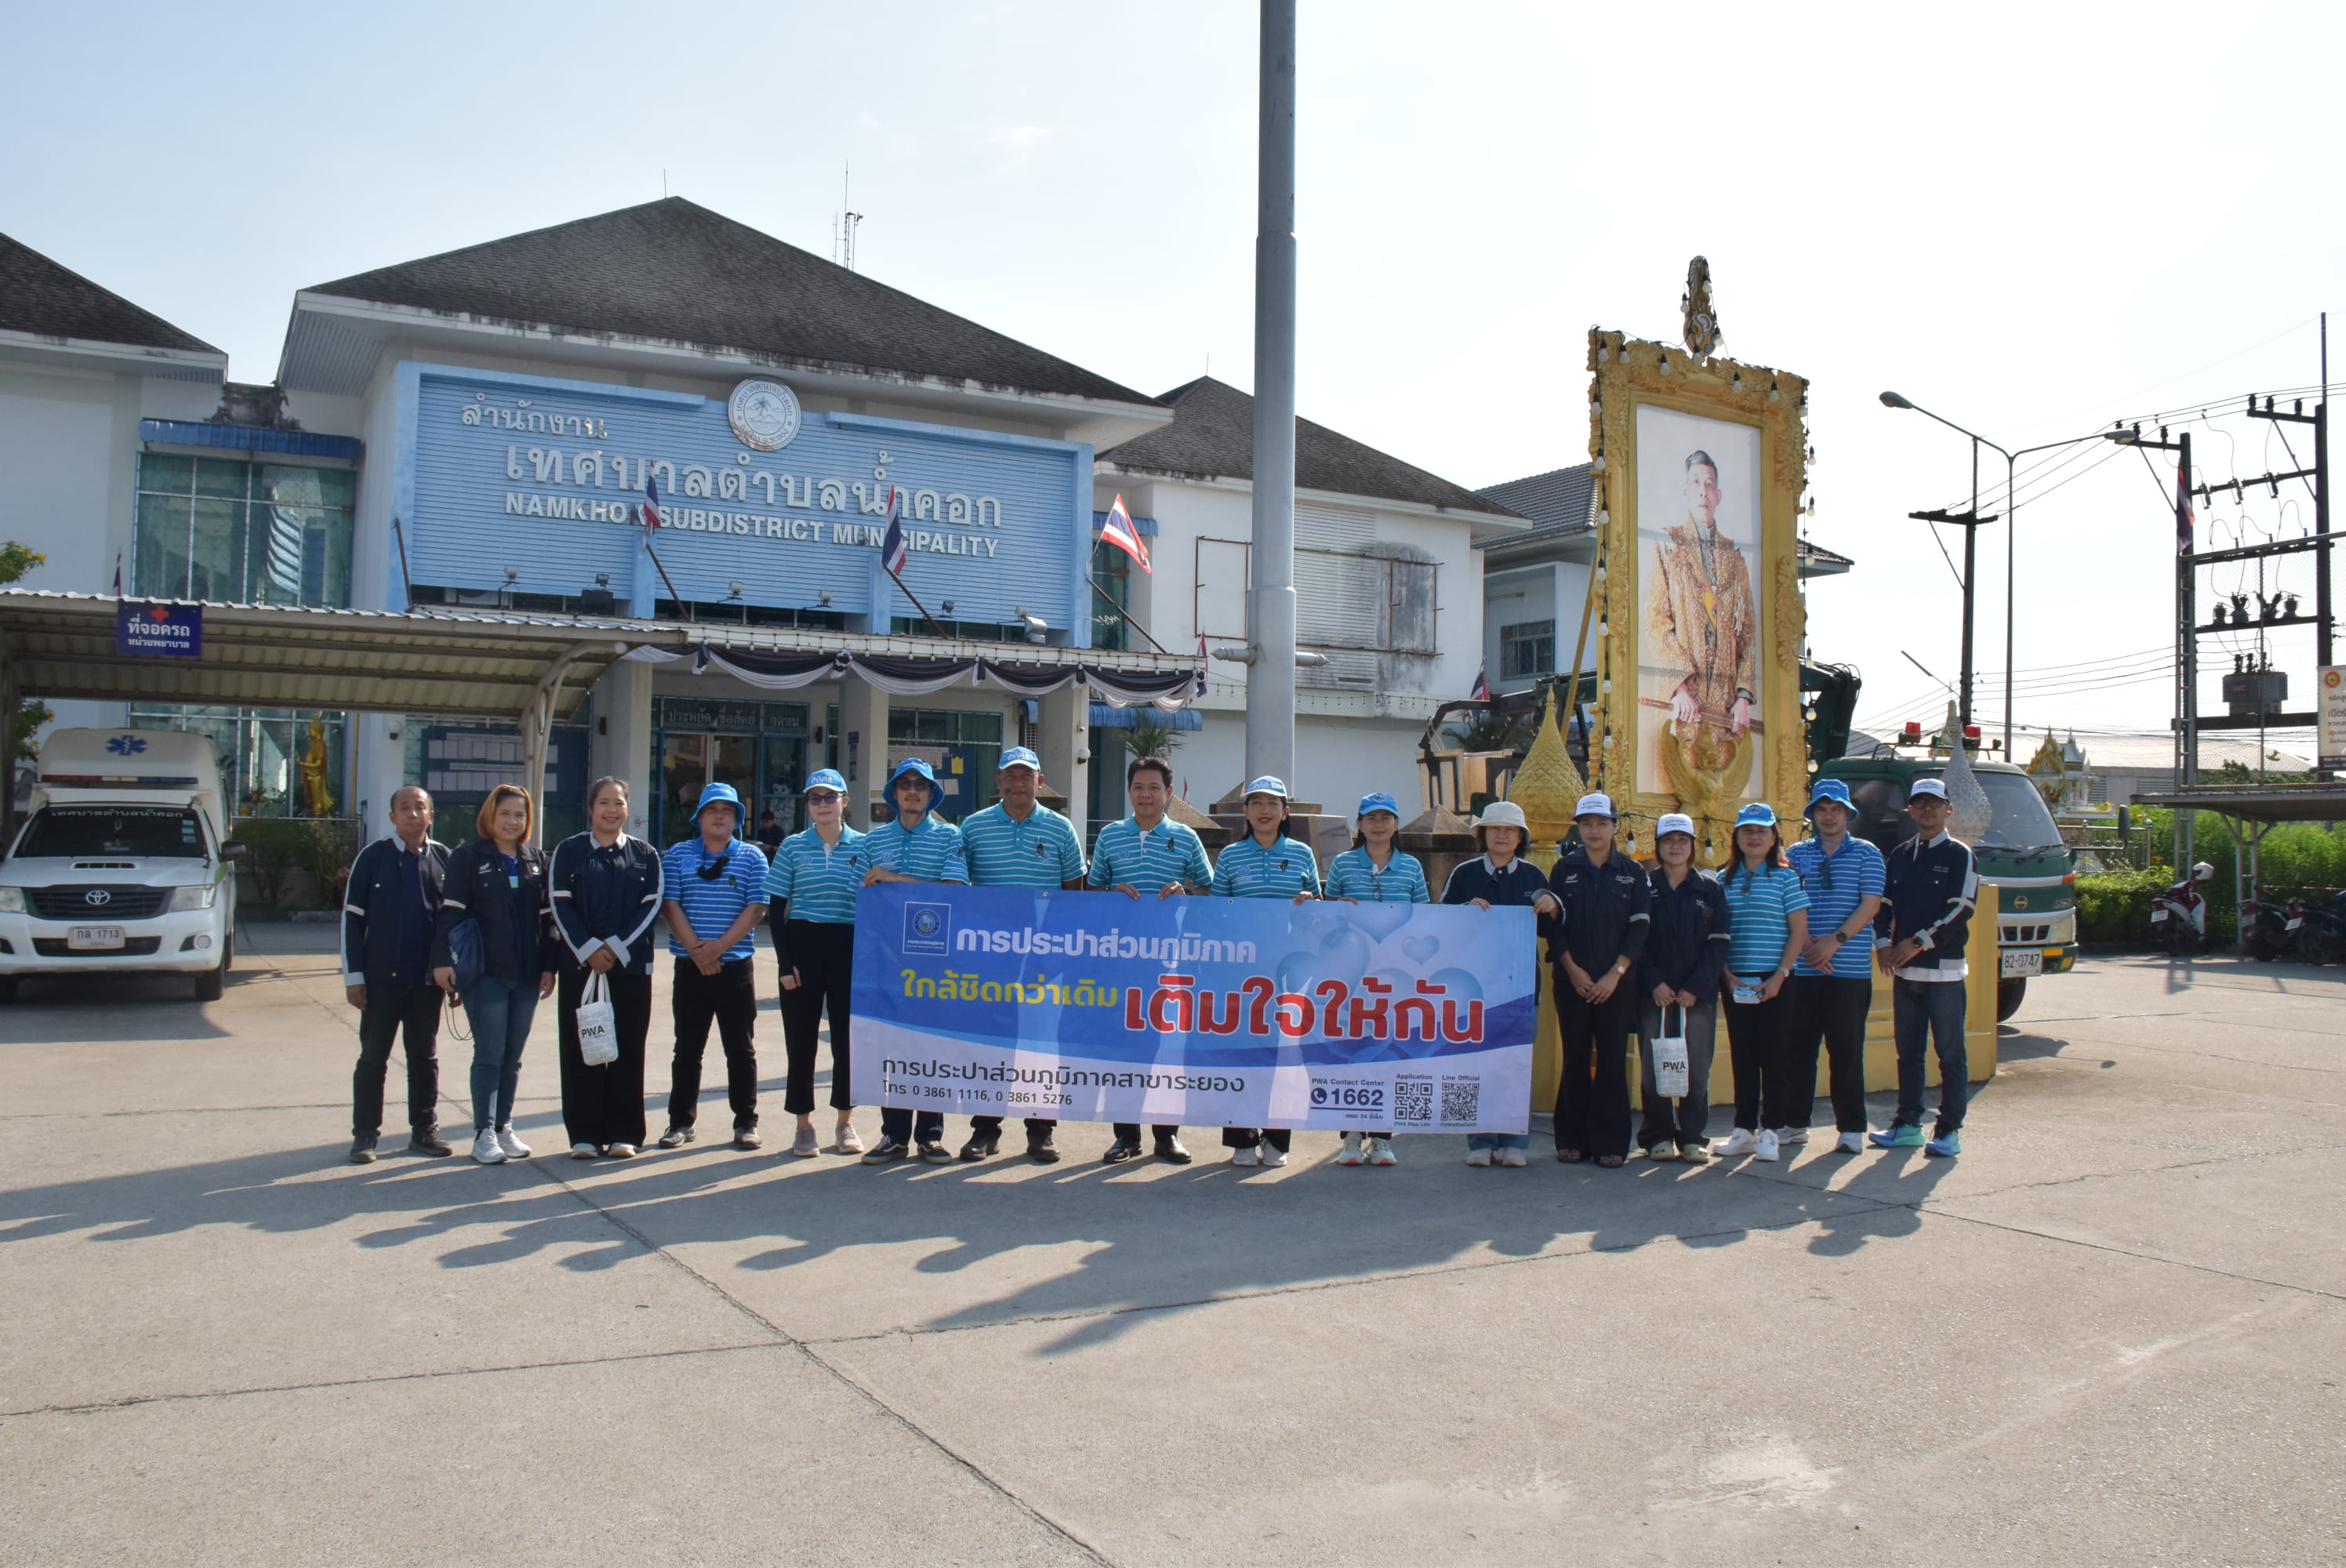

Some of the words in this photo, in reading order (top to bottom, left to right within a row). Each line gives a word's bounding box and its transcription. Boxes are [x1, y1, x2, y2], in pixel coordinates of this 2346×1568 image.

[461, 392, 608, 439] สำนักงาน
[507, 448, 1002, 527] เทศบาลตำบลน้ำคอก
[658, 504, 824, 542] SUBDISTRICT
[127, 613, 191, 637] ที่จอดรถ
[127, 637, 191, 649] หน่วยพยาบาล
[97, 929, 120, 939] 1713
[956, 927, 1256, 969] การประปาส่วนภูมิภาค
[2004, 953, 2040, 969] 82-0747
[901, 969, 1118, 1007] ใกล้ชิดกว่าเดิม
[1124, 975, 1484, 1044] เติมใจให้กัน
[581, 1025, 605, 1038] PWA
[883, 1059, 1245, 1091] การประปาส่วนภูมิภาคสาขาระยอง
[1662, 1061, 1686, 1071] PWA
[883, 1080, 906, 1094] โทร
[912, 1085, 921, 1095] 0
[924, 1087, 952, 1098] 3861
[958, 1089, 991, 1102] 1116,
[995, 1091, 1004, 1102] 0
[1008, 1092, 1037, 1103] 3861
[1043, 1093, 1073, 1105] 5276
[1331, 1087, 1384, 1106] 1662
